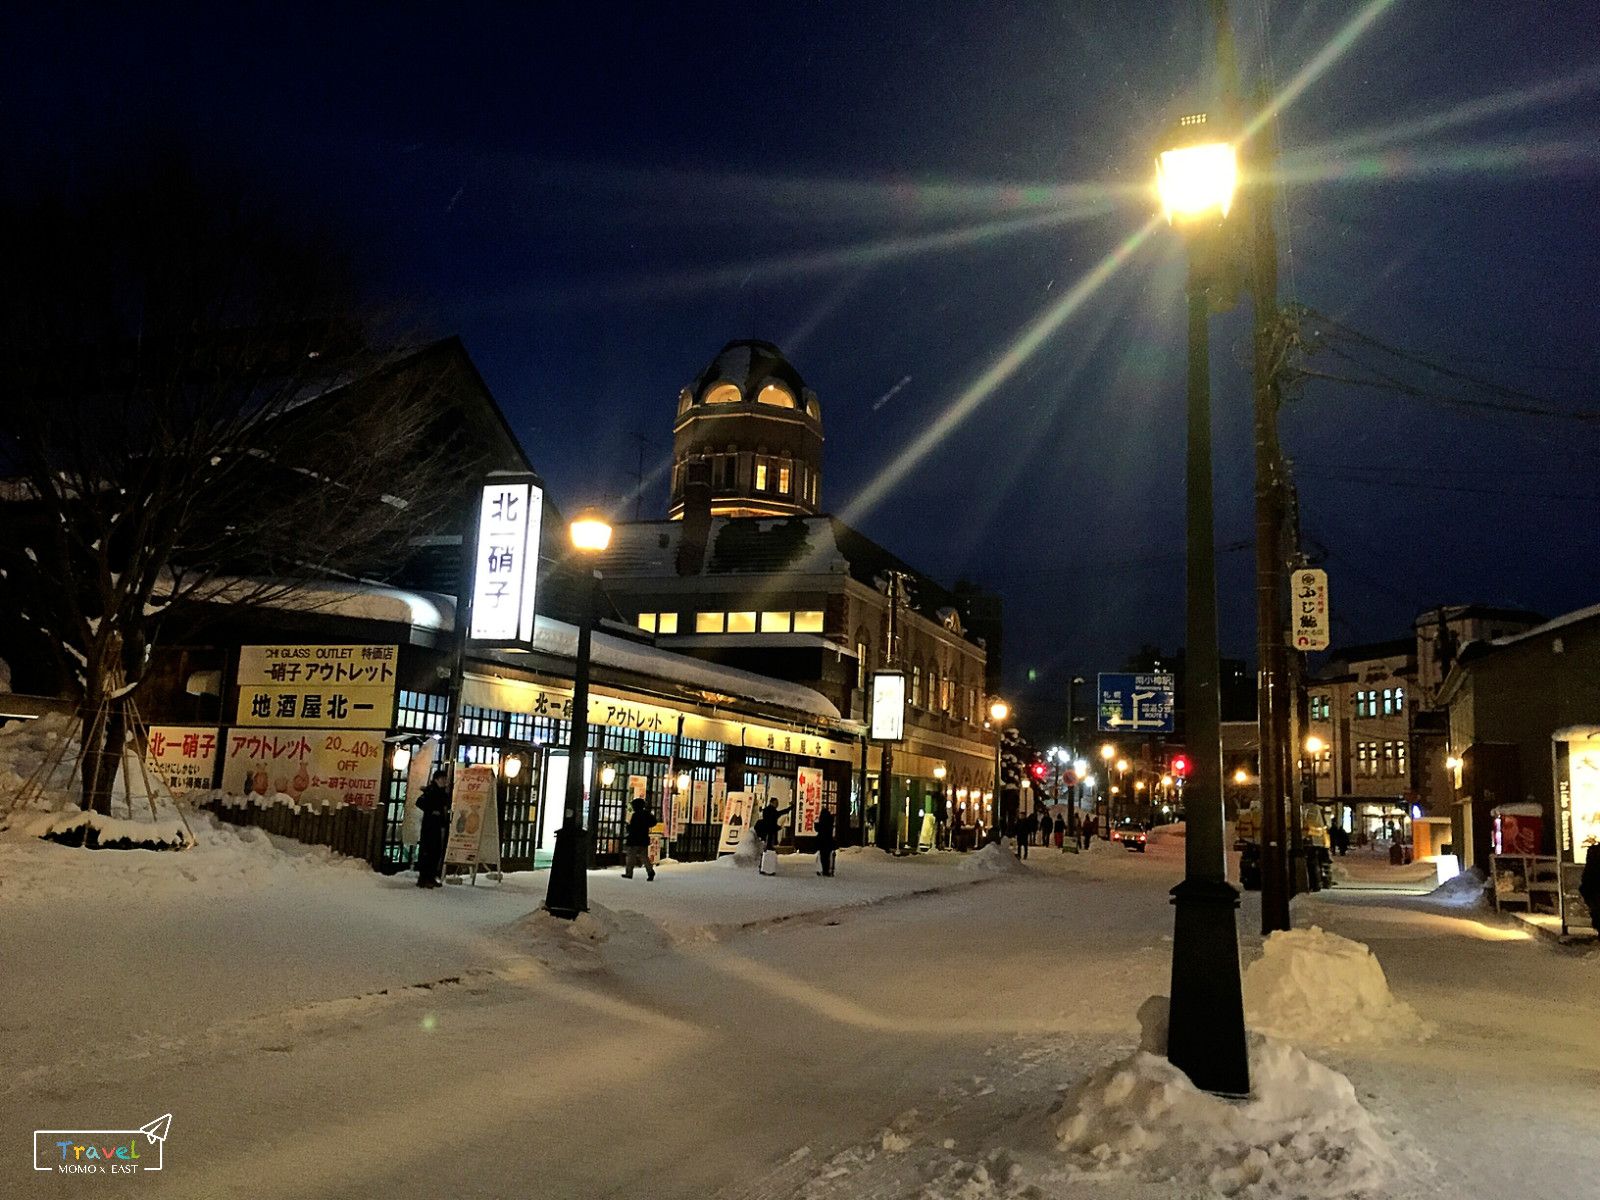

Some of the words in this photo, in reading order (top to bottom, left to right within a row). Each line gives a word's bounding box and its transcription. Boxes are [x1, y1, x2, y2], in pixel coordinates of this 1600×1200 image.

[484, 492, 519, 609] 北一硝子
[281, 648, 310, 659] GLASS
[316, 648, 354, 659] OUTLET
[362, 647, 394, 660] 特価店
[305, 662, 393, 682] アウトレット
[251, 693, 374, 719] 地酒屋北一
[606, 706, 662, 730] アウトレット
[149, 732, 216, 759] 北一硝子
[230, 735, 312, 760] アウトレット
[337, 760, 359, 772] OFF
[166, 776, 210, 790] 買い得商品
